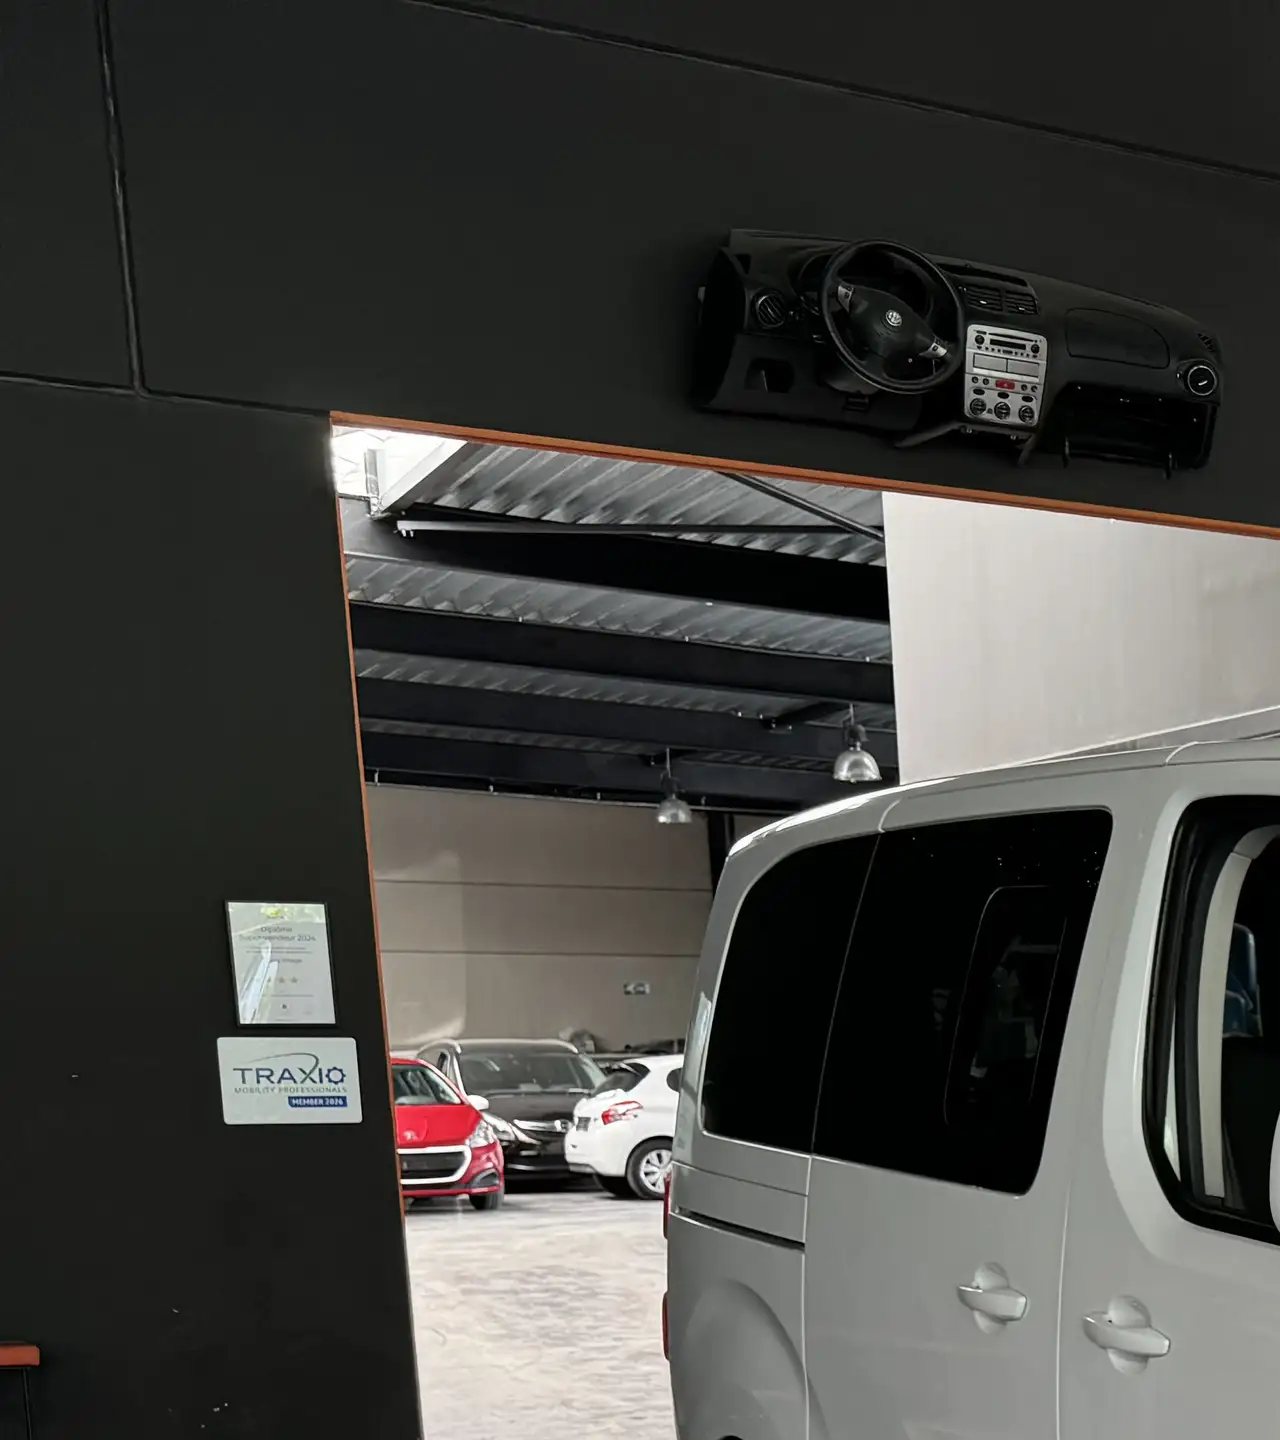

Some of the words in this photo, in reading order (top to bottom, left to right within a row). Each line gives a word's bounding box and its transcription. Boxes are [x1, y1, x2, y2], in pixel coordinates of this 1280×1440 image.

[233, 1066, 347, 1085] TRAXIO
[234, 1087, 277, 1095] MOBILITY
[278, 1086, 348, 1094] PROFESSIONALS
[292, 1098, 325, 1106] MEMBER
